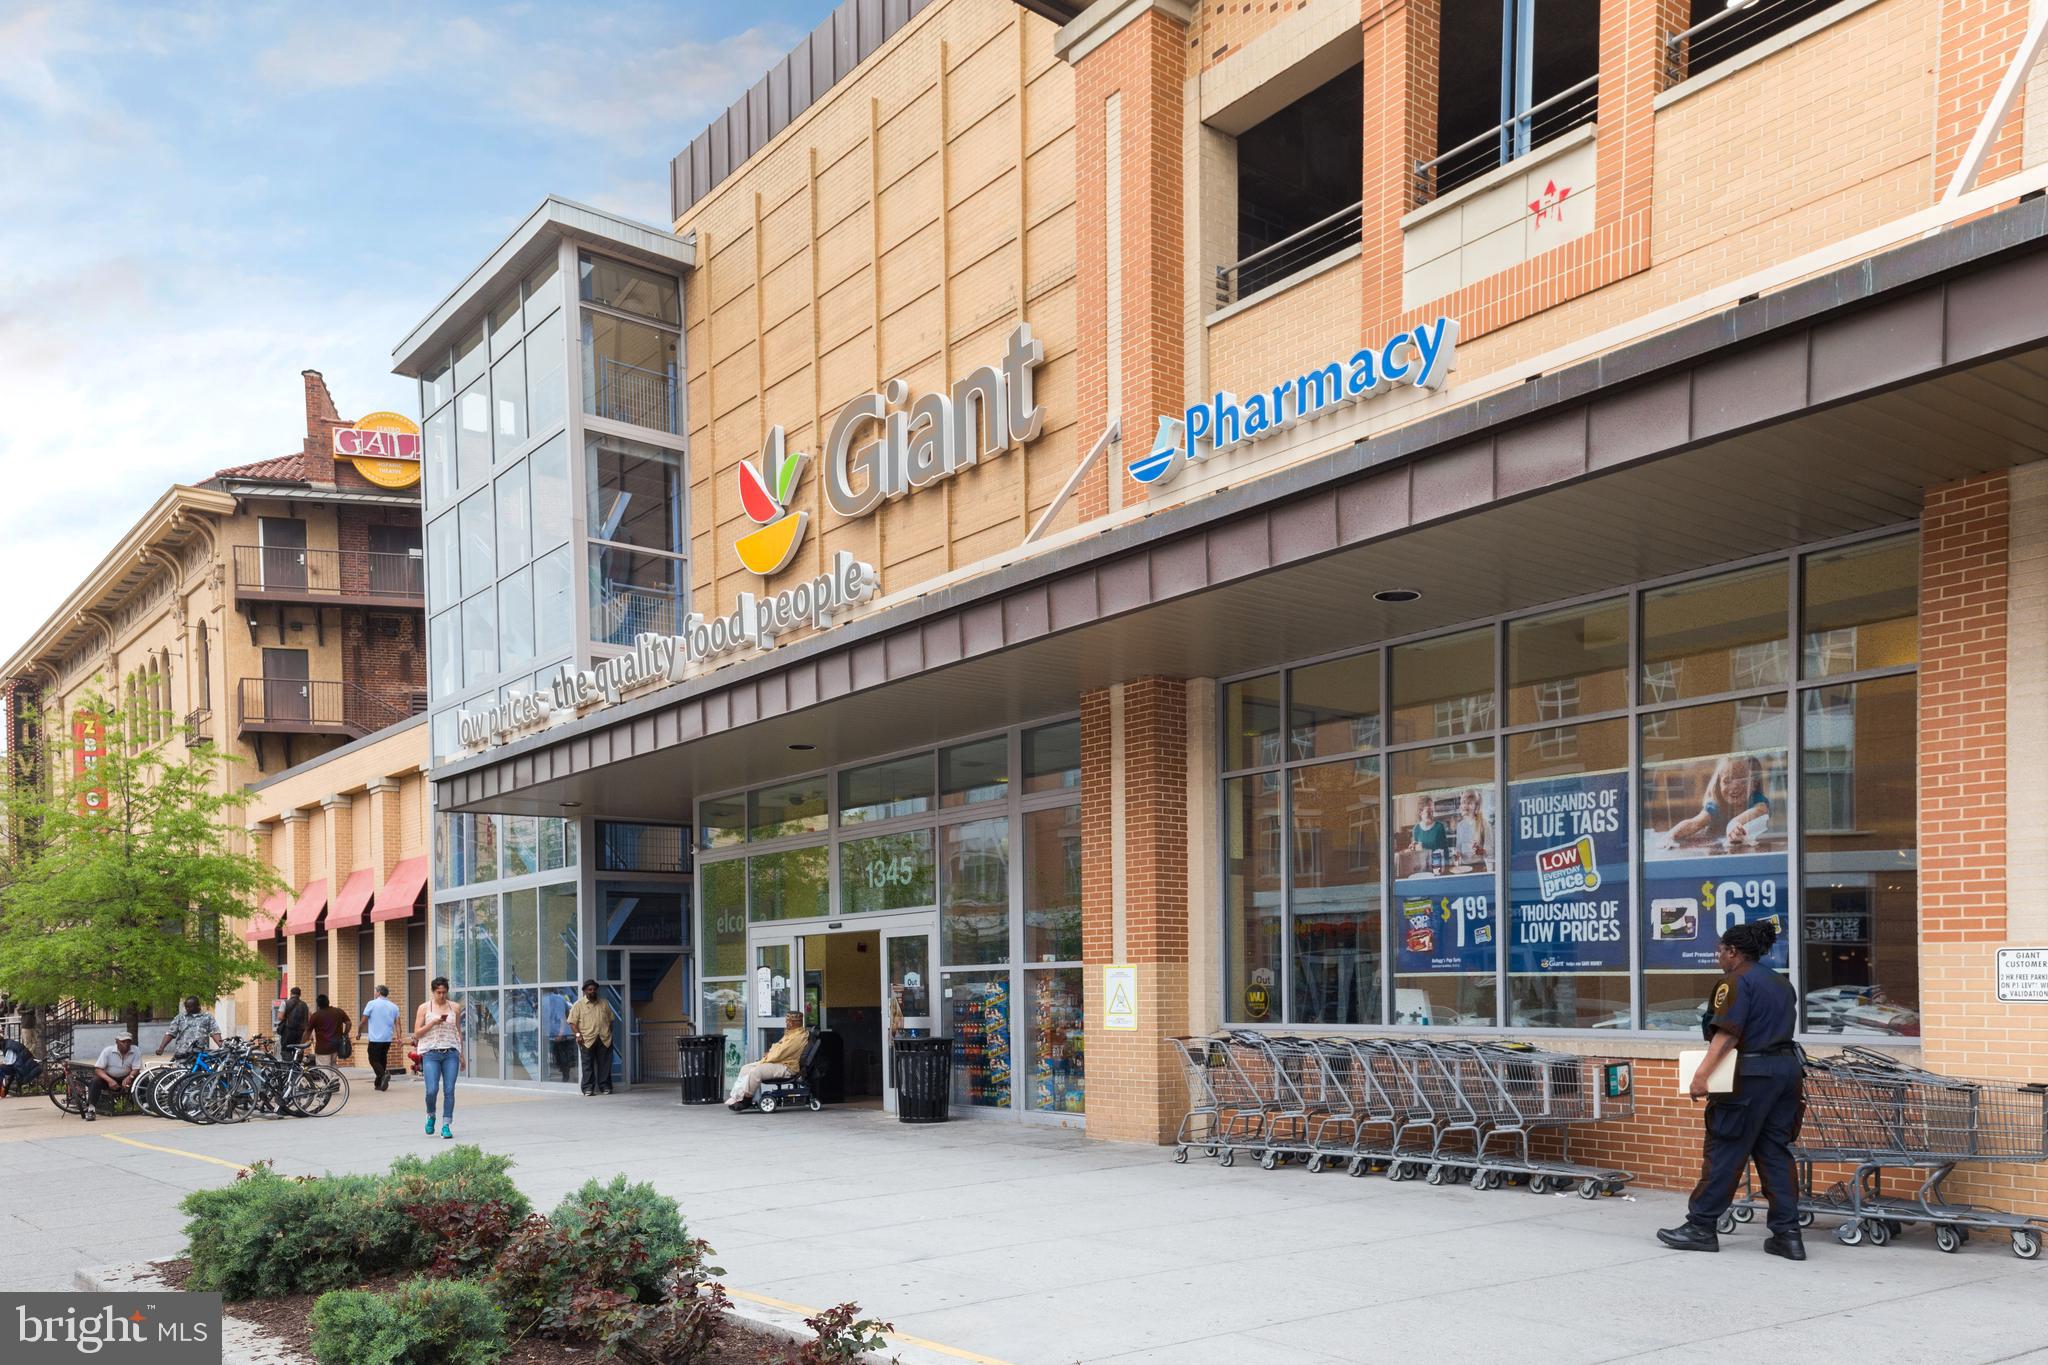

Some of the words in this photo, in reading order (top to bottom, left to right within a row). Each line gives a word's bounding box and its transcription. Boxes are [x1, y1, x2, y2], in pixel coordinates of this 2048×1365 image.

[1185, 315, 1452, 460] Pharmacy
[824, 321, 1044, 517] Giant
[335, 429, 420, 459] GAL
[456, 710, 485, 744] low
[488, 691, 545, 744] prices
[552, 663, 588, 709] the
[595, 633, 678, 704] quality
[683, 593, 747, 662] food
[756, 550, 868, 650] people
[1520, 791, 1596, 816] THOUSANDS
[1600, 789, 1618, 808] OF
[1520, 813, 1566, 840] BLUE
[1570, 808, 1619, 835] TAGS
[865, 855, 913, 889] 1345
[1542, 848, 1577, 871] LOW
[1543, 865, 1581, 881] EVERYDAY
[1544, 873, 1584, 896] price
[1521, 901, 1597, 922] THOUSANDS
[1600, 900, 1618, 919] OF
[1521, 922, 1555, 944] LOW
[1560, 919, 1621, 942] PRICES
[907, 979, 918, 987] Out
[1255, 975, 1271, 985] Out
